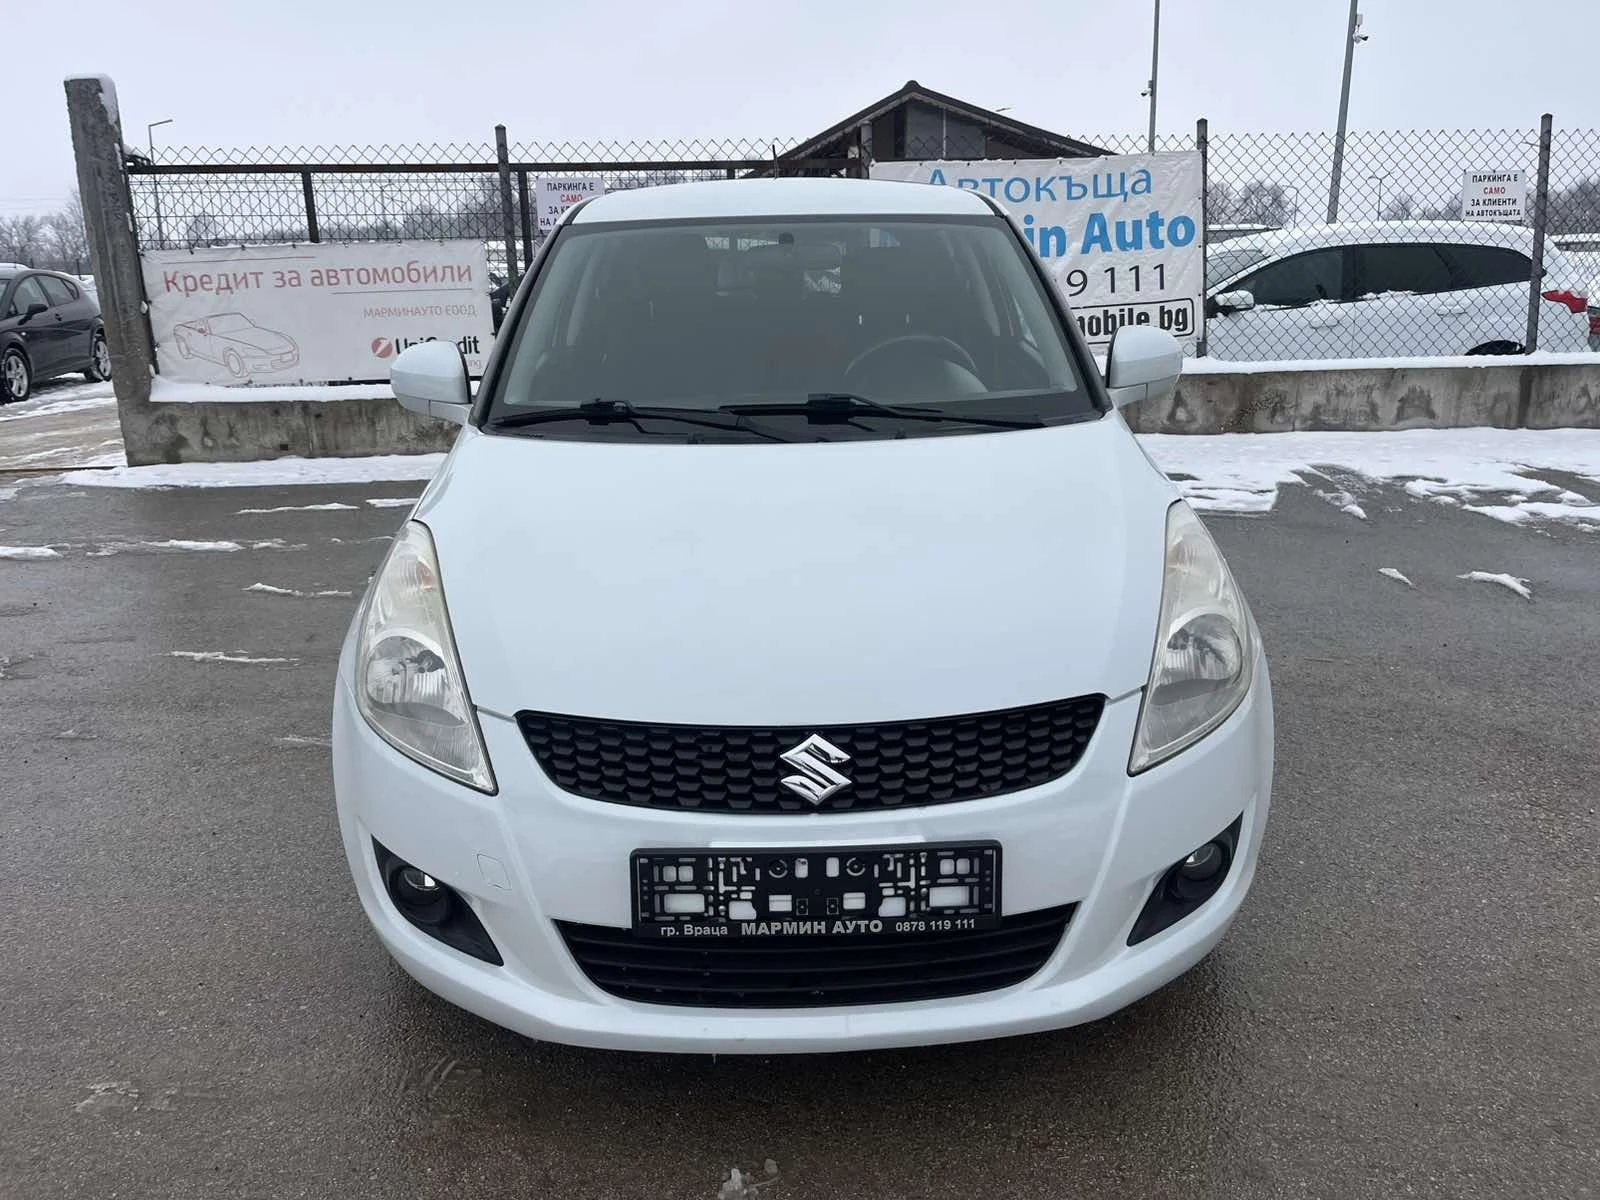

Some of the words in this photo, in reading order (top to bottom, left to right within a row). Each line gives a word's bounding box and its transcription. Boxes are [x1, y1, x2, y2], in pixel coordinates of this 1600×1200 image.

[1472, 174, 1512, 183] ПАРКИНГА
[1513, 174, 1518, 182] Е
[547, 182, 587, 192] ПАРКИНГА
[589, 182, 595, 191] Е
[1483, 186, 1506, 195] САМО
[560, 194, 583, 203] САМО
[1471, 199, 1480, 207] ЗА
[1482, 198, 1517, 207] КЛИЕНТИ
[548, 206, 560, 215] ЗА
[1465, 209, 1475, 217] НА
[1476, 209, 1521, 217] АВТОКЪЩАТА
[540, 217, 551, 226] НА
[1023, 214, 1067, 259] in
[1080, 210, 1196, 256] Auto
[164, 271, 264, 297] Кредит
[273, 270, 301, 289] за
[310, 260, 473, 287] автомобили
[1104, 263, 1165, 294] 111
[363, 305, 442, 318] МАРМИНАУТО
[445, 303, 478, 317] ЕООД
[1076, 305, 1189, 337] obilebg
[660, 926, 680, 937] гр.
[683, 924, 729, 937] Враца
[741, 921, 827, 936] МАРМИН
[831, 920, 884, 934] АУТО
[895, 922, 926, 932] 0878
[929, 920, 952, 931] 119
[955, 919, 976, 930] 111
